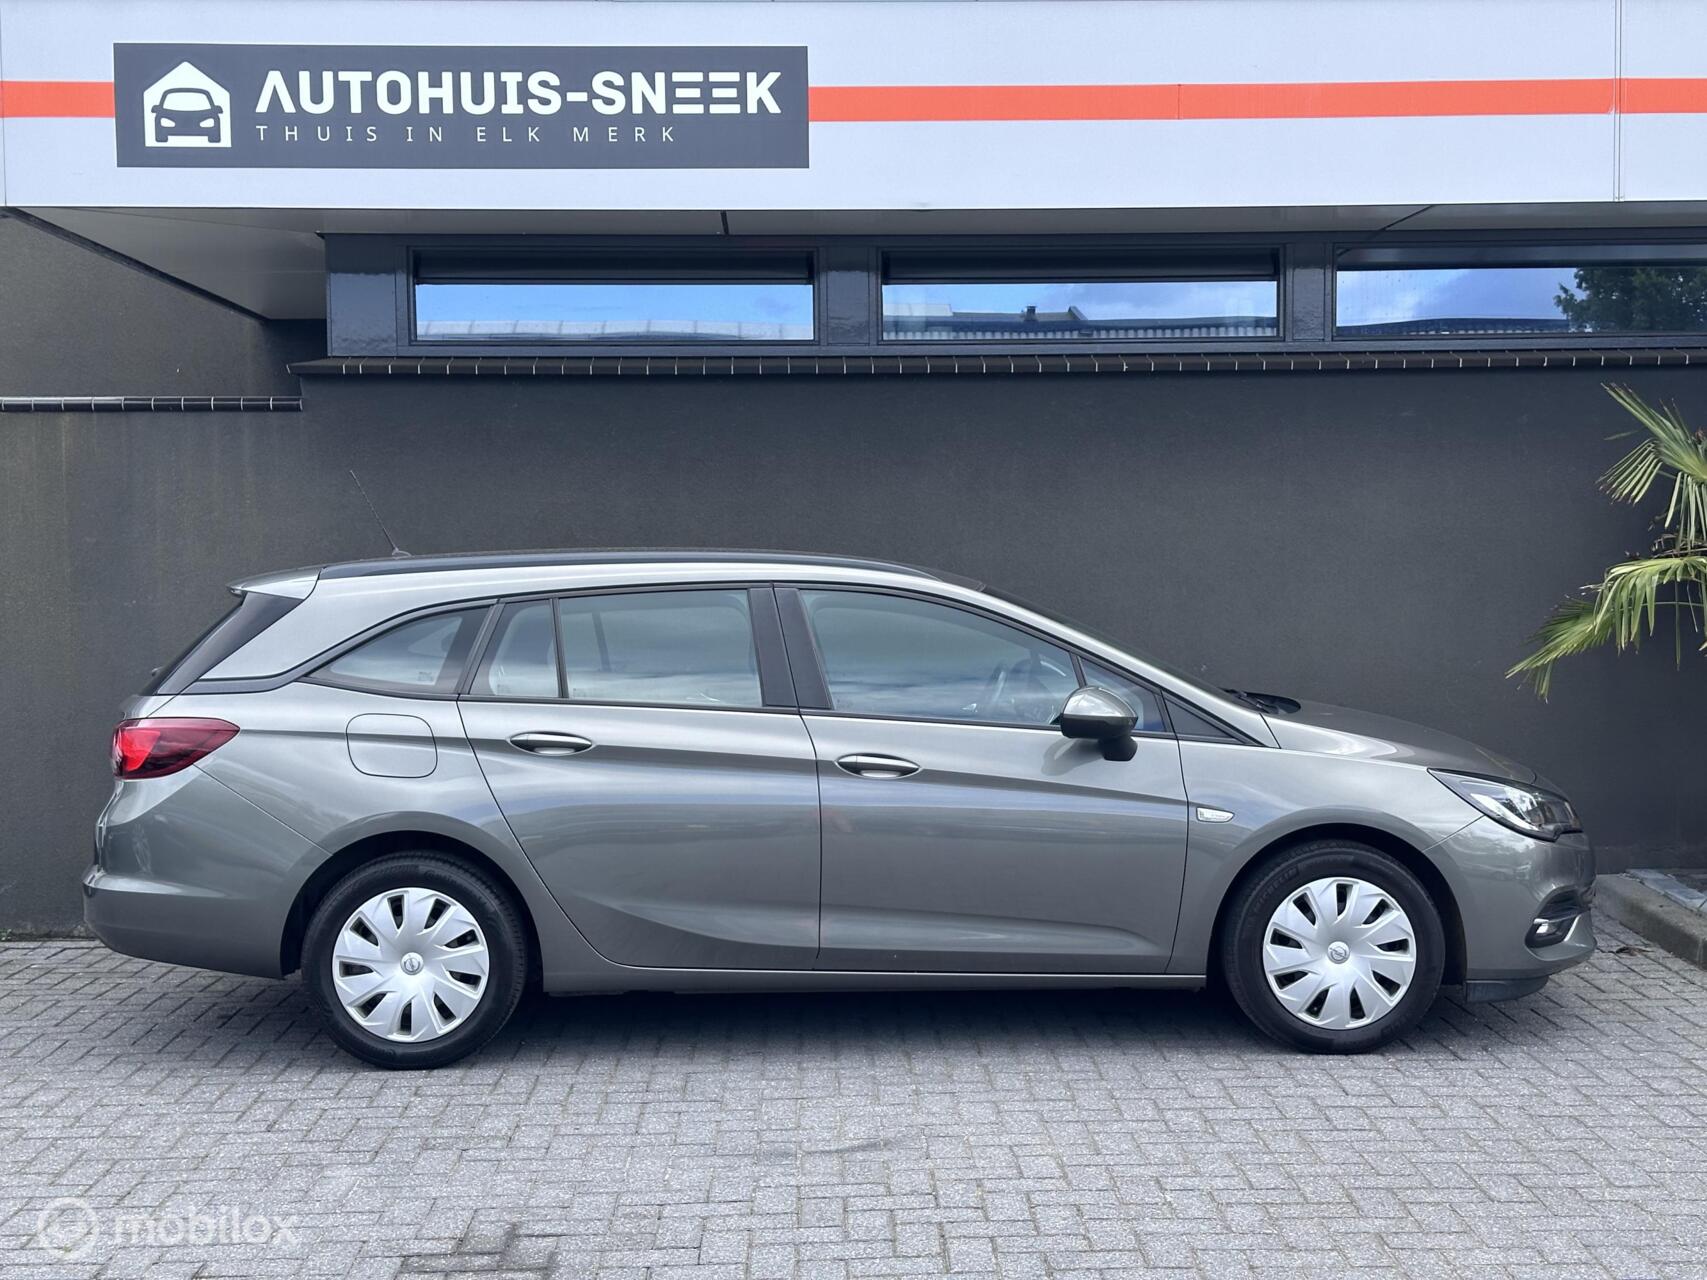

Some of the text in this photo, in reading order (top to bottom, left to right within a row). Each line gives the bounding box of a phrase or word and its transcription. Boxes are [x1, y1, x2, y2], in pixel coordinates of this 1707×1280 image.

[255, 70, 782, 115] AUTOHUIS-SNEEK
[255, 124, 675, 145] THUIS IN ELK MERK
